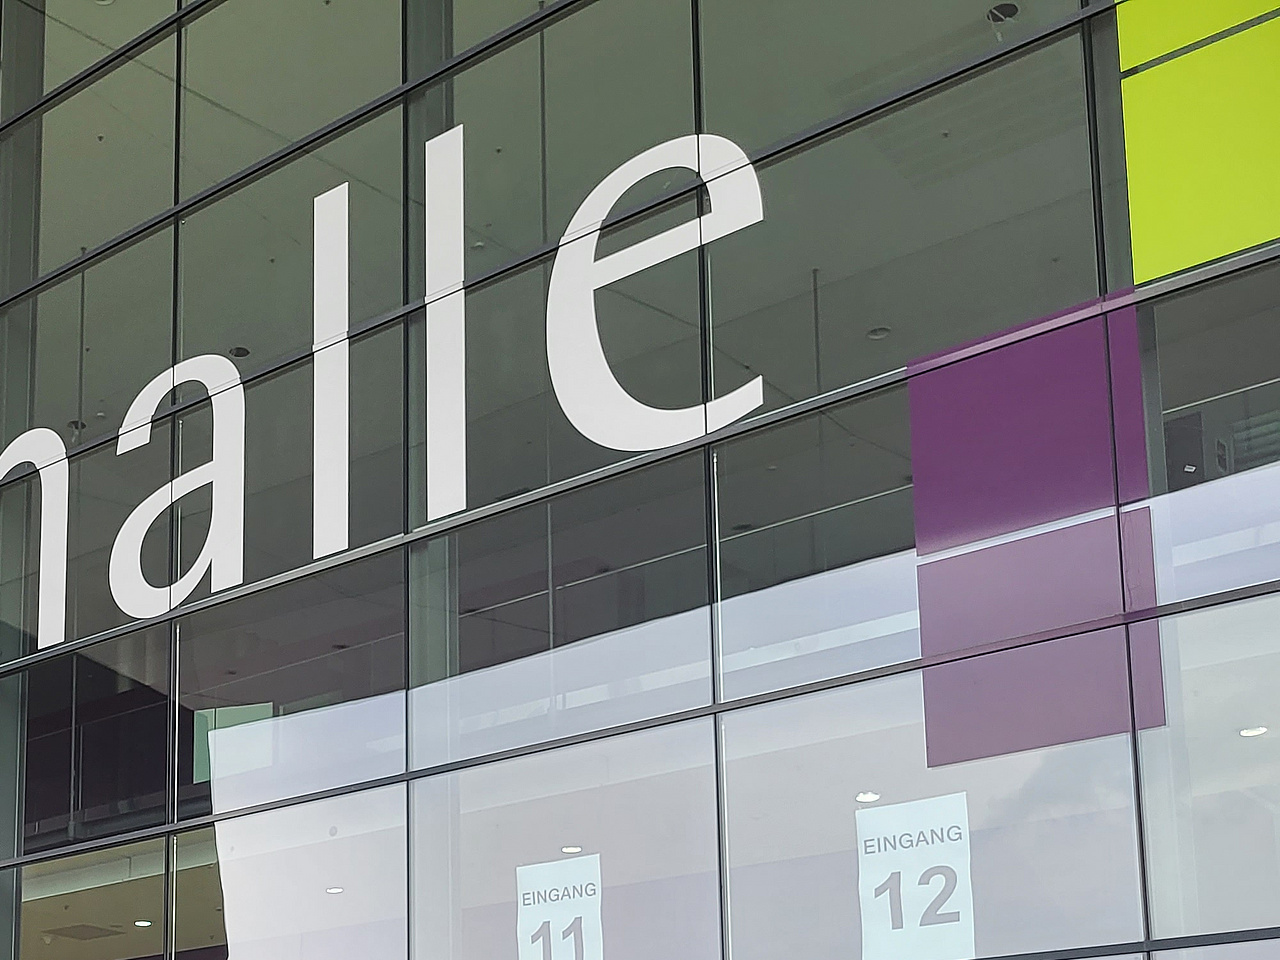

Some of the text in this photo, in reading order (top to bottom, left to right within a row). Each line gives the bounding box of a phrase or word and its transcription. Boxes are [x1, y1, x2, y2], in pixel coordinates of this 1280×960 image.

[862, 823, 963, 856] EINGANG
[521, 881, 597, 908] EINGANG
[873, 865, 960, 931] 12
